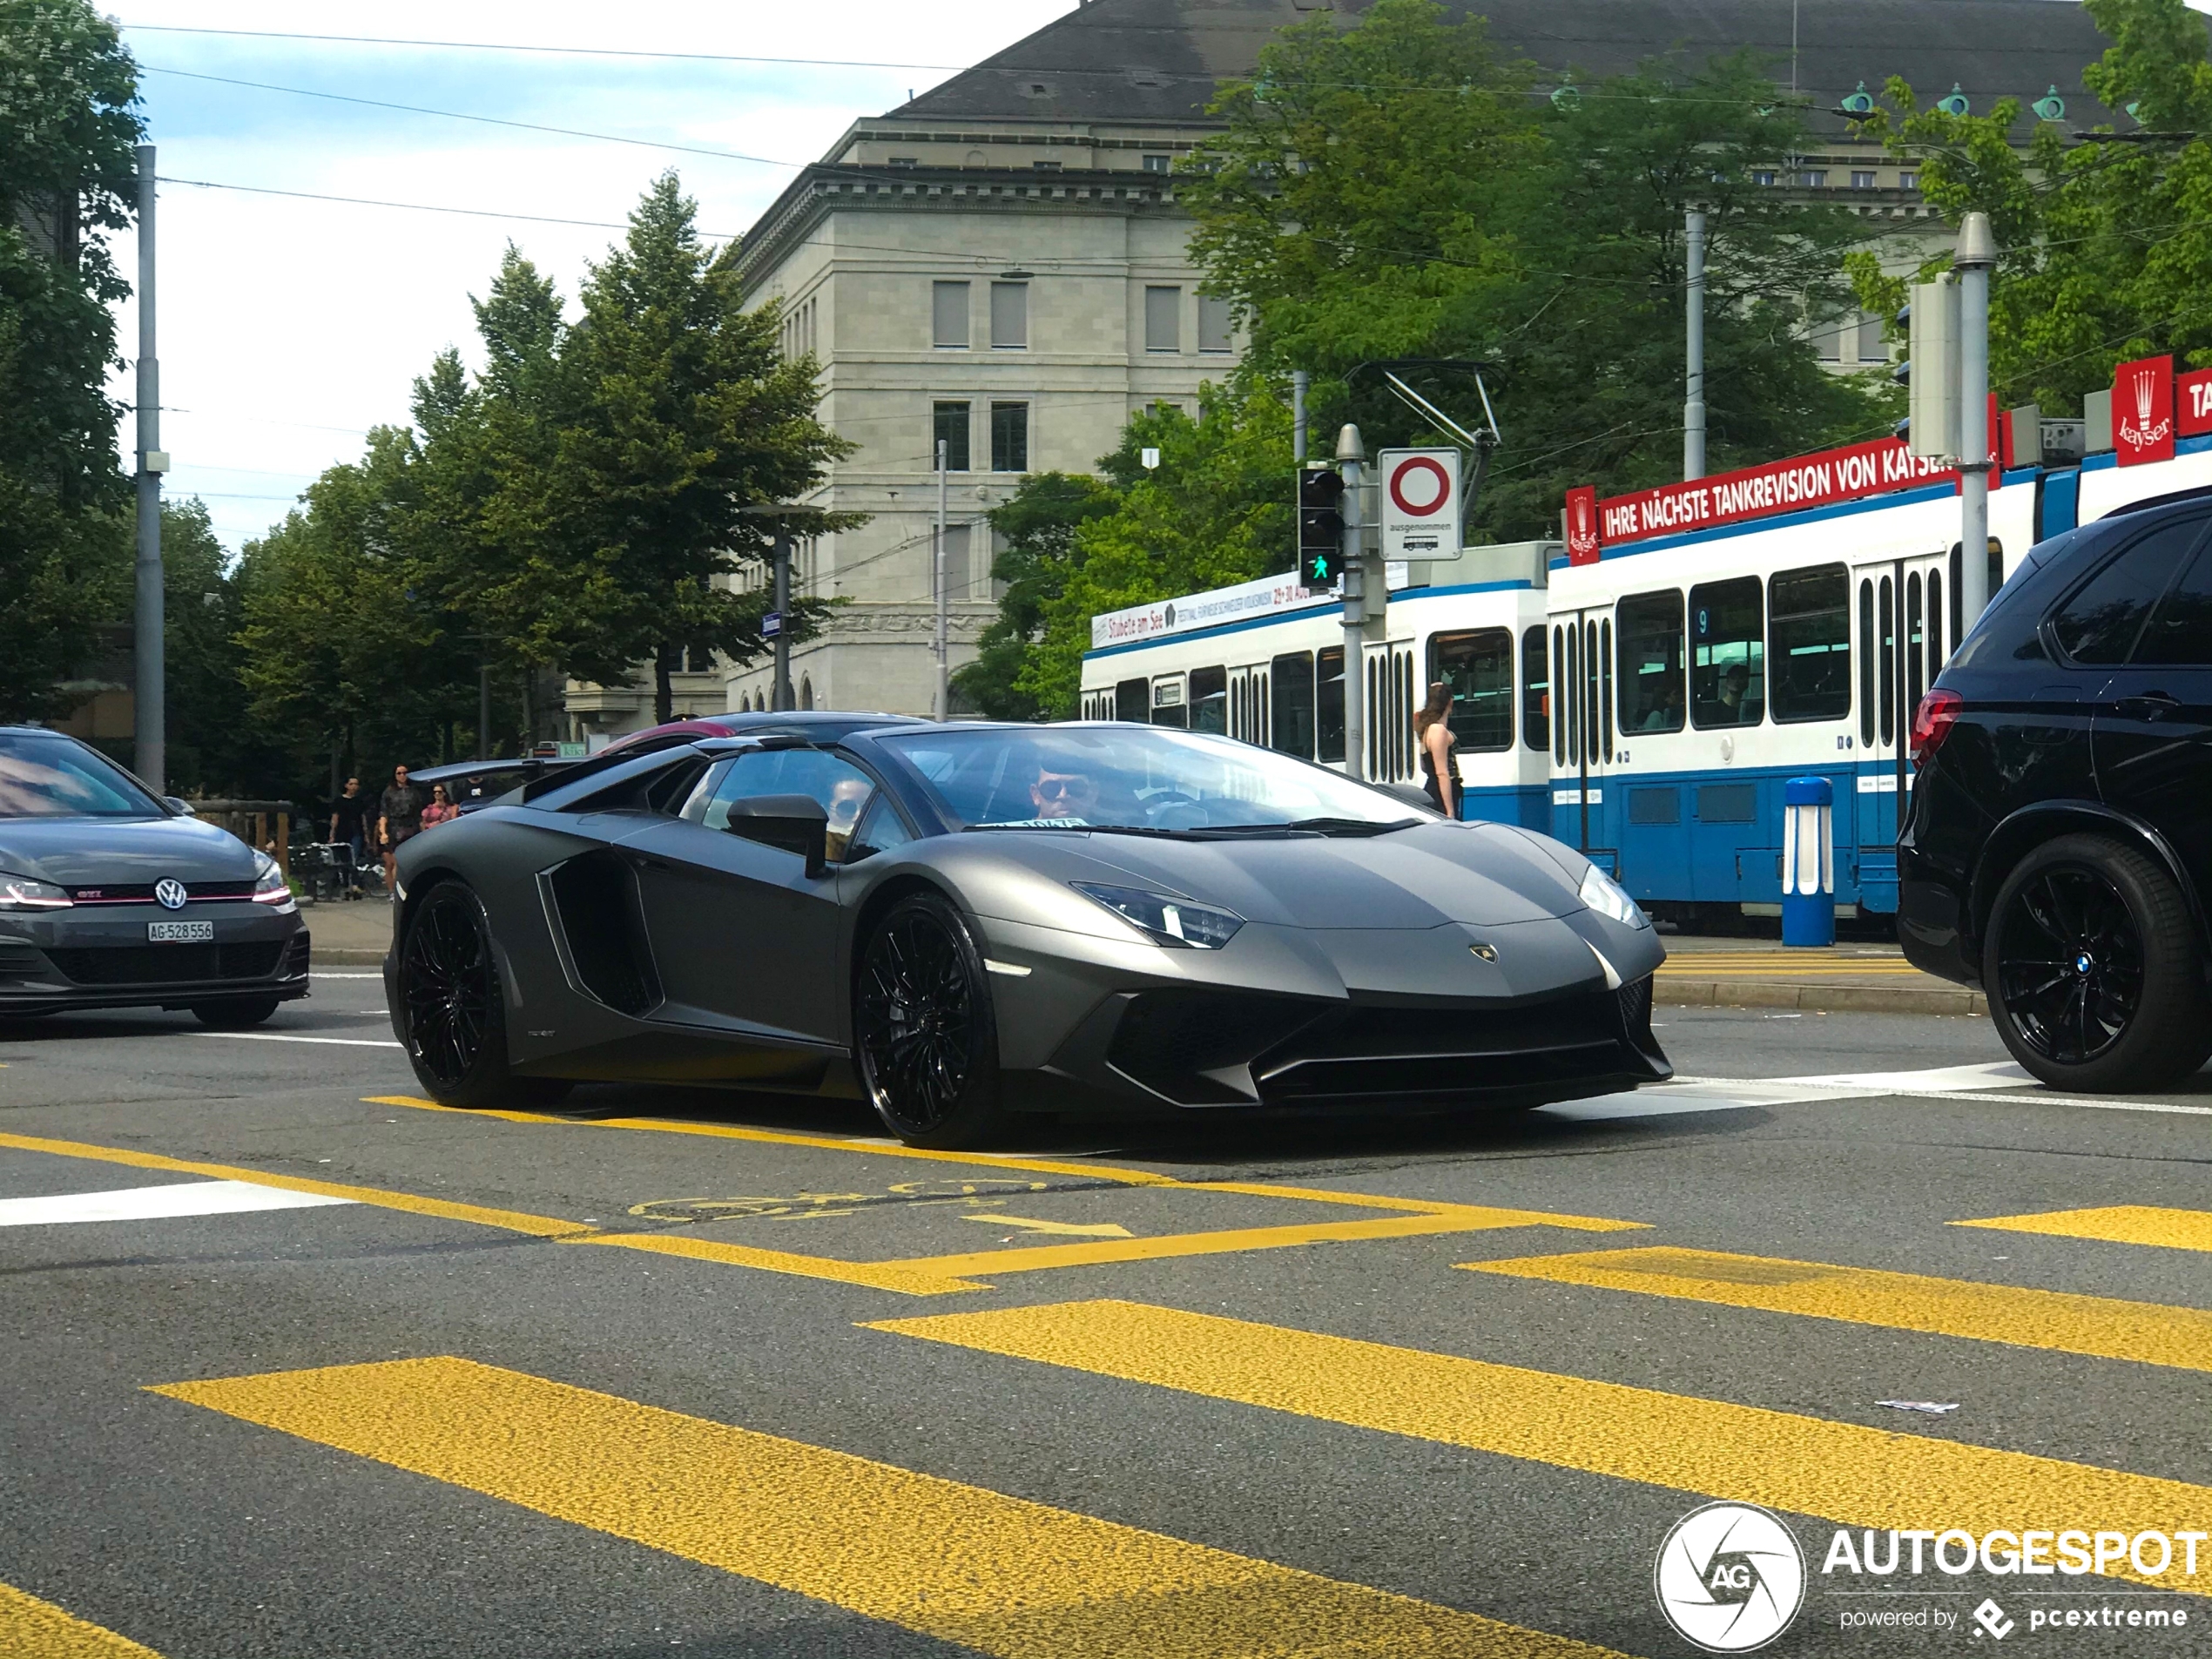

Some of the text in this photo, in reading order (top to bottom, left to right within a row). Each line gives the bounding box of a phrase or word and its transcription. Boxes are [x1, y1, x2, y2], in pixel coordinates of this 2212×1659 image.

[2119, 416, 2169, 452] kayser
[1605, 503, 1638, 537] IHRE
[1642, 490, 1710, 531] NÄCHSTE
[1712, 462, 1831, 516] TANKREVISION
[1836, 453, 1877, 492] VON
[1390, 523, 1452, 533] ausgenommen
[1570, 530, 1596, 557] kayser
[1109, 613, 1136, 638] Stubete
[1137, 617, 1148, 634] am
[1150, 610, 1163, 631] See
[1699, 610, 1707, 634] 9
